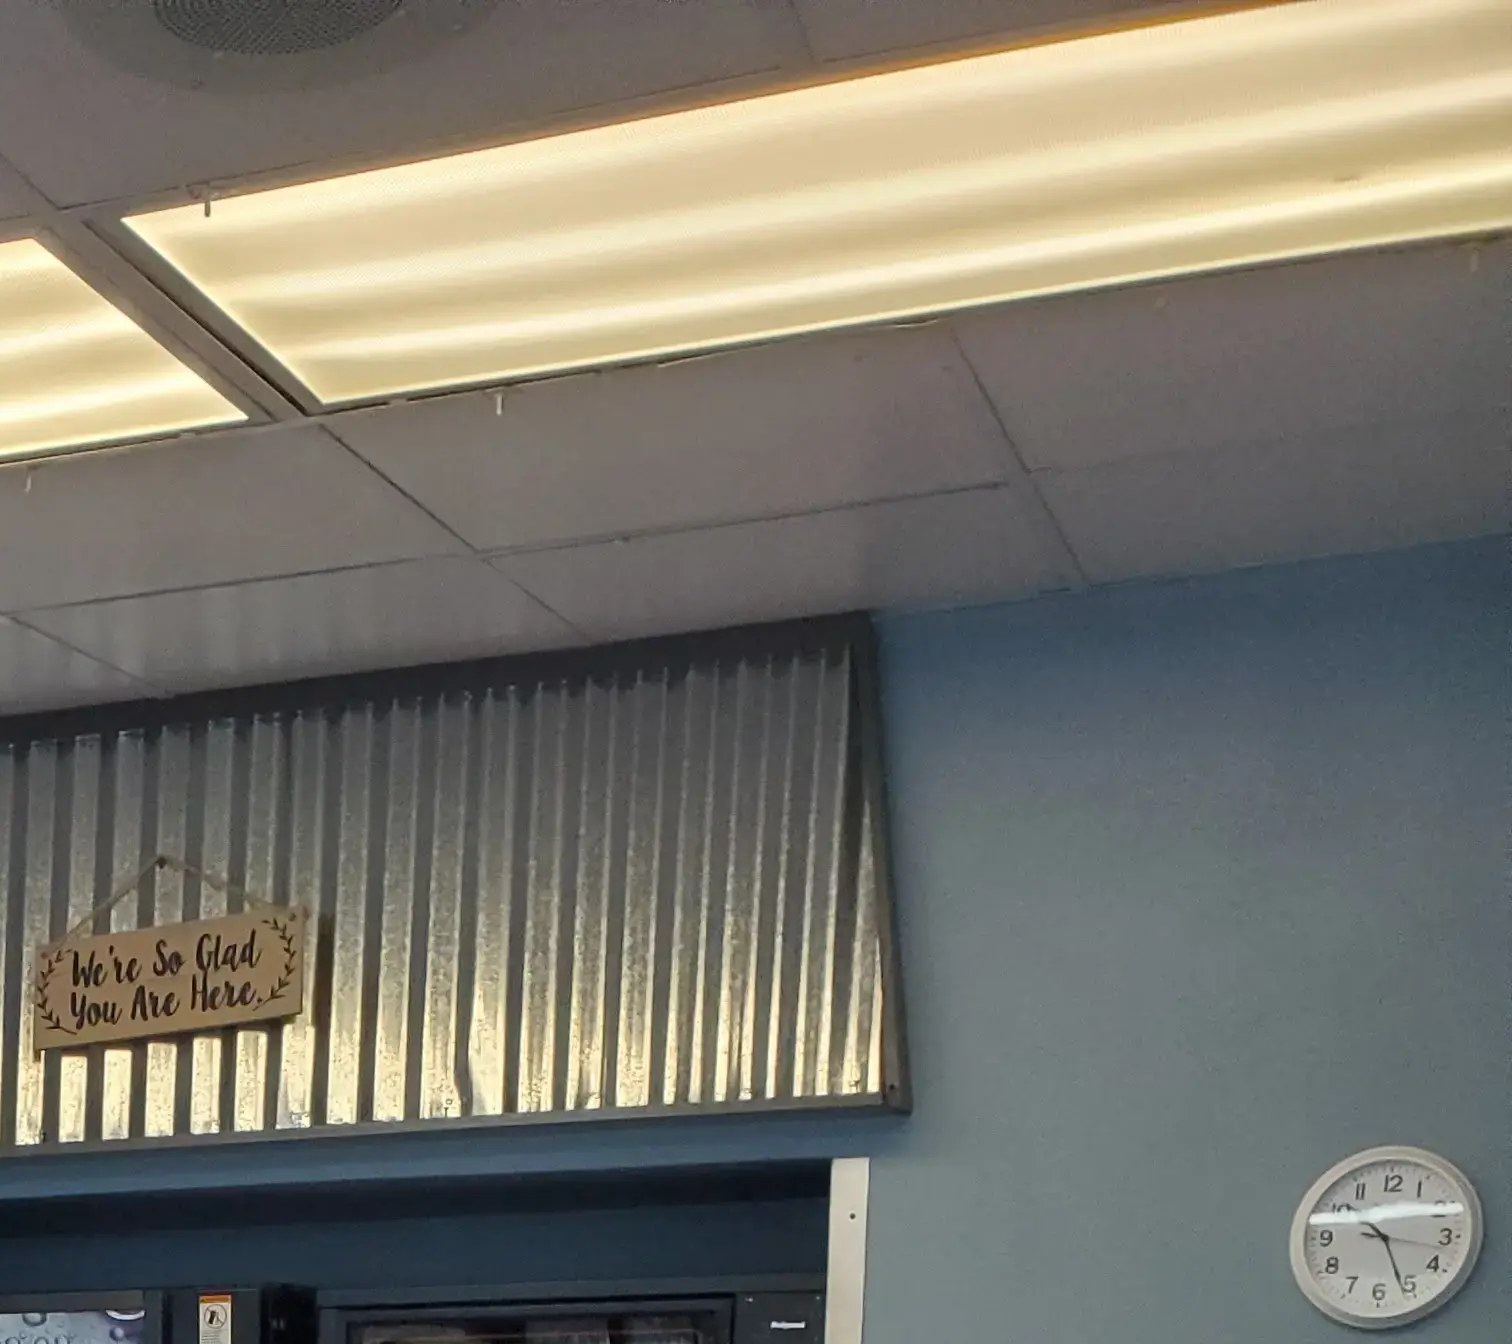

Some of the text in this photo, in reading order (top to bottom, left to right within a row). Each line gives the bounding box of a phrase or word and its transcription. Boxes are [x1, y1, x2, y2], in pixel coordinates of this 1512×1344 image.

[72, 928, 263, 988] We're So Glad
[70, 972, 264, 1031] You Are Here.
[1355, 1183, 1366, 1201] 11
[1383, 1174, 1404, 1193] 12
[1416, 1180, 1423, 1198] 1
[1319, 1229, 1334, 1247] 9
[1438, 1228, 1453, 1246] 3
[1325, 1256, 1340, 1274] 8
[1426, 1254, 1440, 1273] 4
[1346, 1276, 1359, 1294] 7
[1371, 1283, 1387, 1301] 6
[1403, 1275, 1417, 1293] 5
